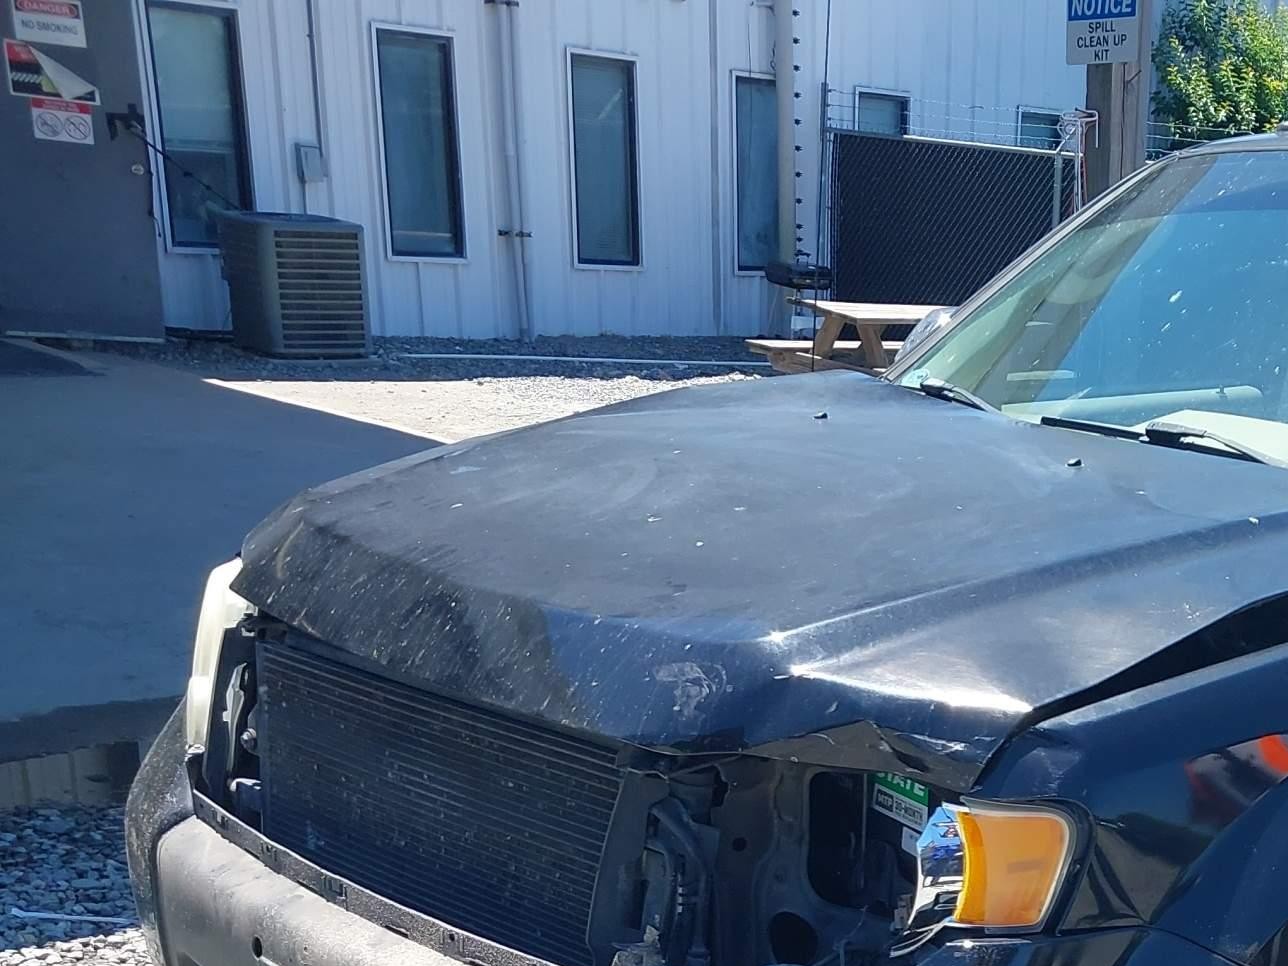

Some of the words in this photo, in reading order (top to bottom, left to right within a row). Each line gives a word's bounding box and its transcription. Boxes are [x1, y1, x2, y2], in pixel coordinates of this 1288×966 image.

[1071, 0, 1132, 17] NOTICE
[21, 20, 35, 30] NO
[36, 21, 79, 36] SMOKING
[1088, 20, 1116, 34] SPILL
[1076, 35, 1110, 49] CLEAN
[1113, 34, 1127, 47] UP
[1094, 49, 1110, 62] KIT
